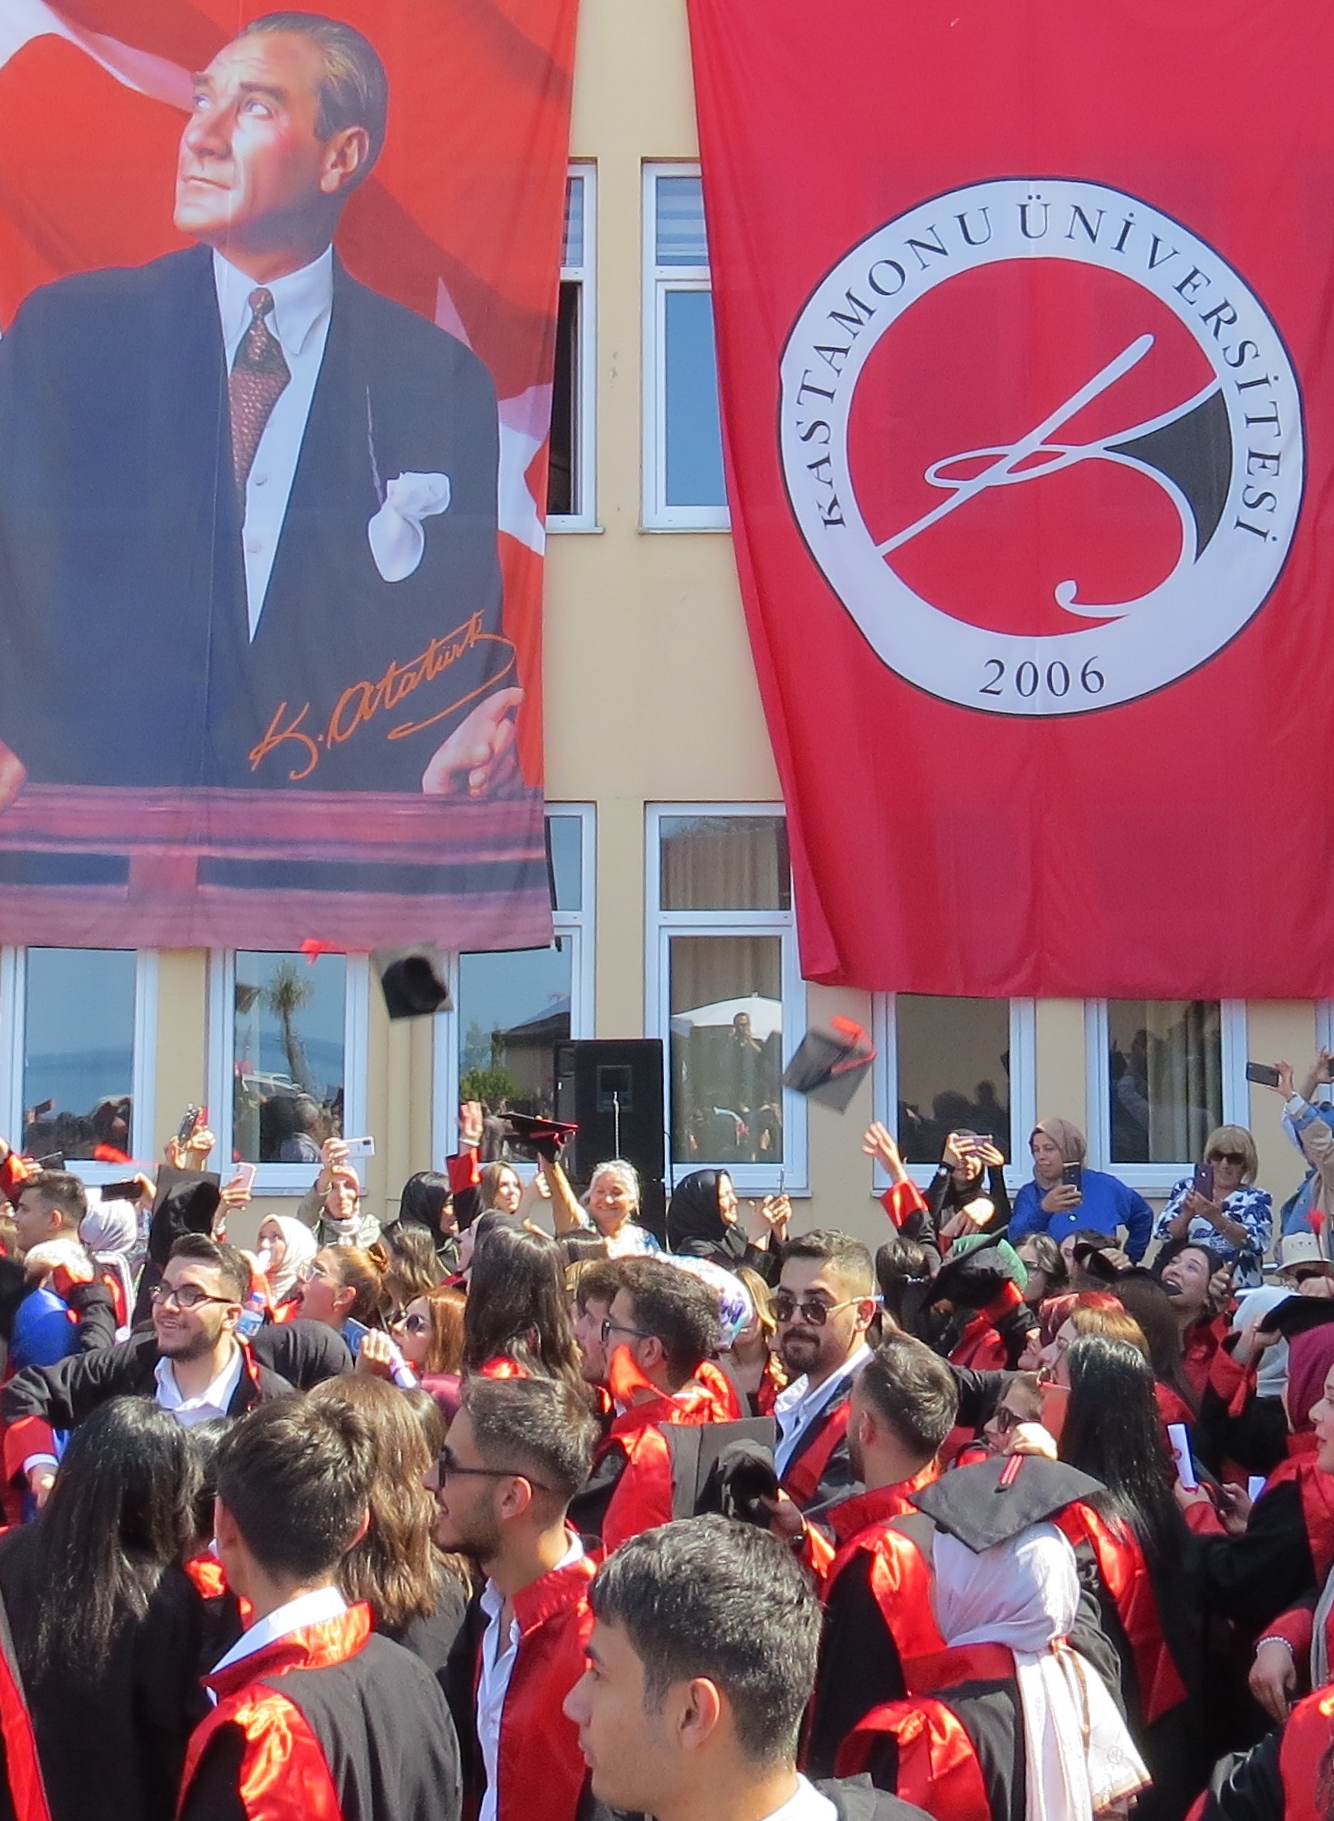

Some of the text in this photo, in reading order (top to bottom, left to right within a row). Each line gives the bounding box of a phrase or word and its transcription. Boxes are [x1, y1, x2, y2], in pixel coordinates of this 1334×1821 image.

[796, 194, 1282, 544] KASTAMONU ÜNİVERSİTESİ
[978, 656, 1106, 698] 2006
